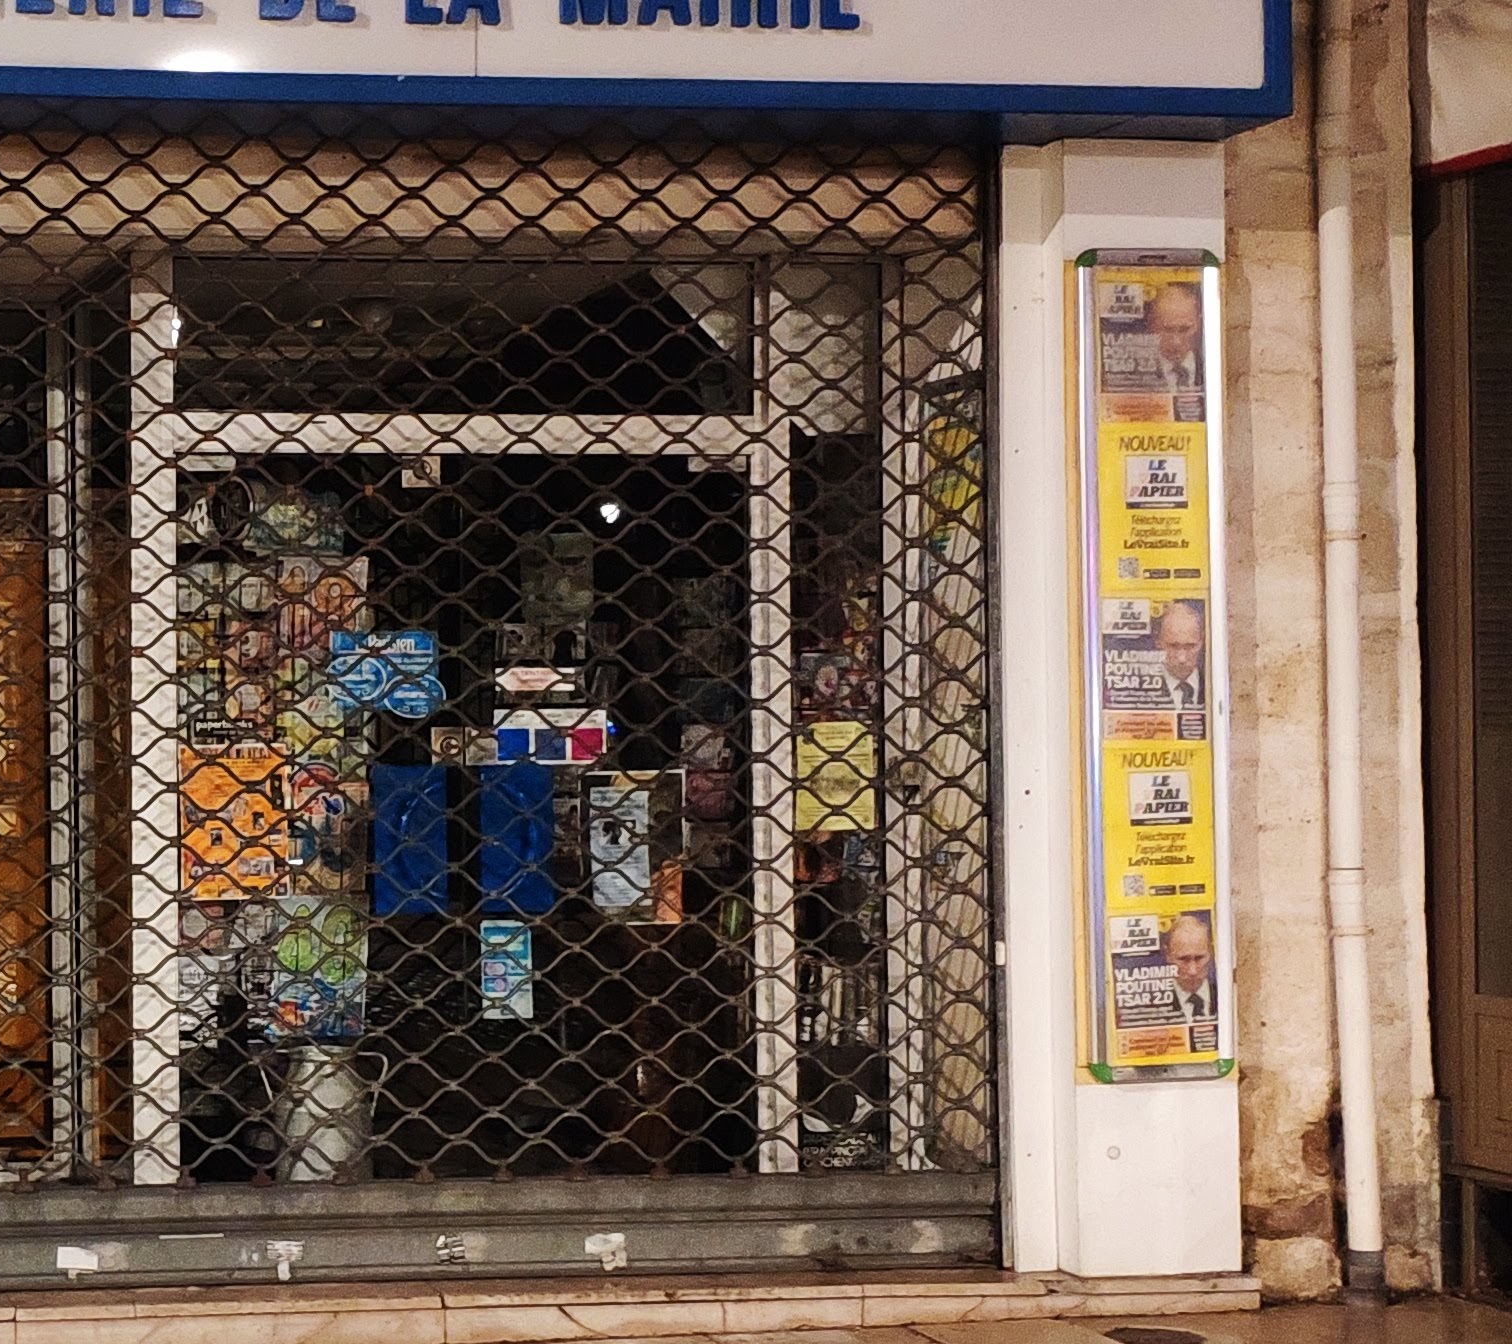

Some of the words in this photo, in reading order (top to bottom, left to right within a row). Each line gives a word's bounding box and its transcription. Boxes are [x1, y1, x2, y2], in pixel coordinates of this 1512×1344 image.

[1148, 459, 1168, 471] LE
[1105, 662, 1164, 676] POUTINE
[1105, 676, 1140, 688] TSAR
[1142, 676, 1163, 689] 2.0
[195, 719, 254, 732] paperbnks
[1150, 774, 1171, 787] LE
[1134, 800, 1190, 814] PAPIER
[1114, 964, 1179, 981] VLADIMIR
[1116, 979, 1174, 994] POUTINE
[1116, 993, 1151, 1008] TSAR
[1152, 991, 1174, 1006] 2.0
